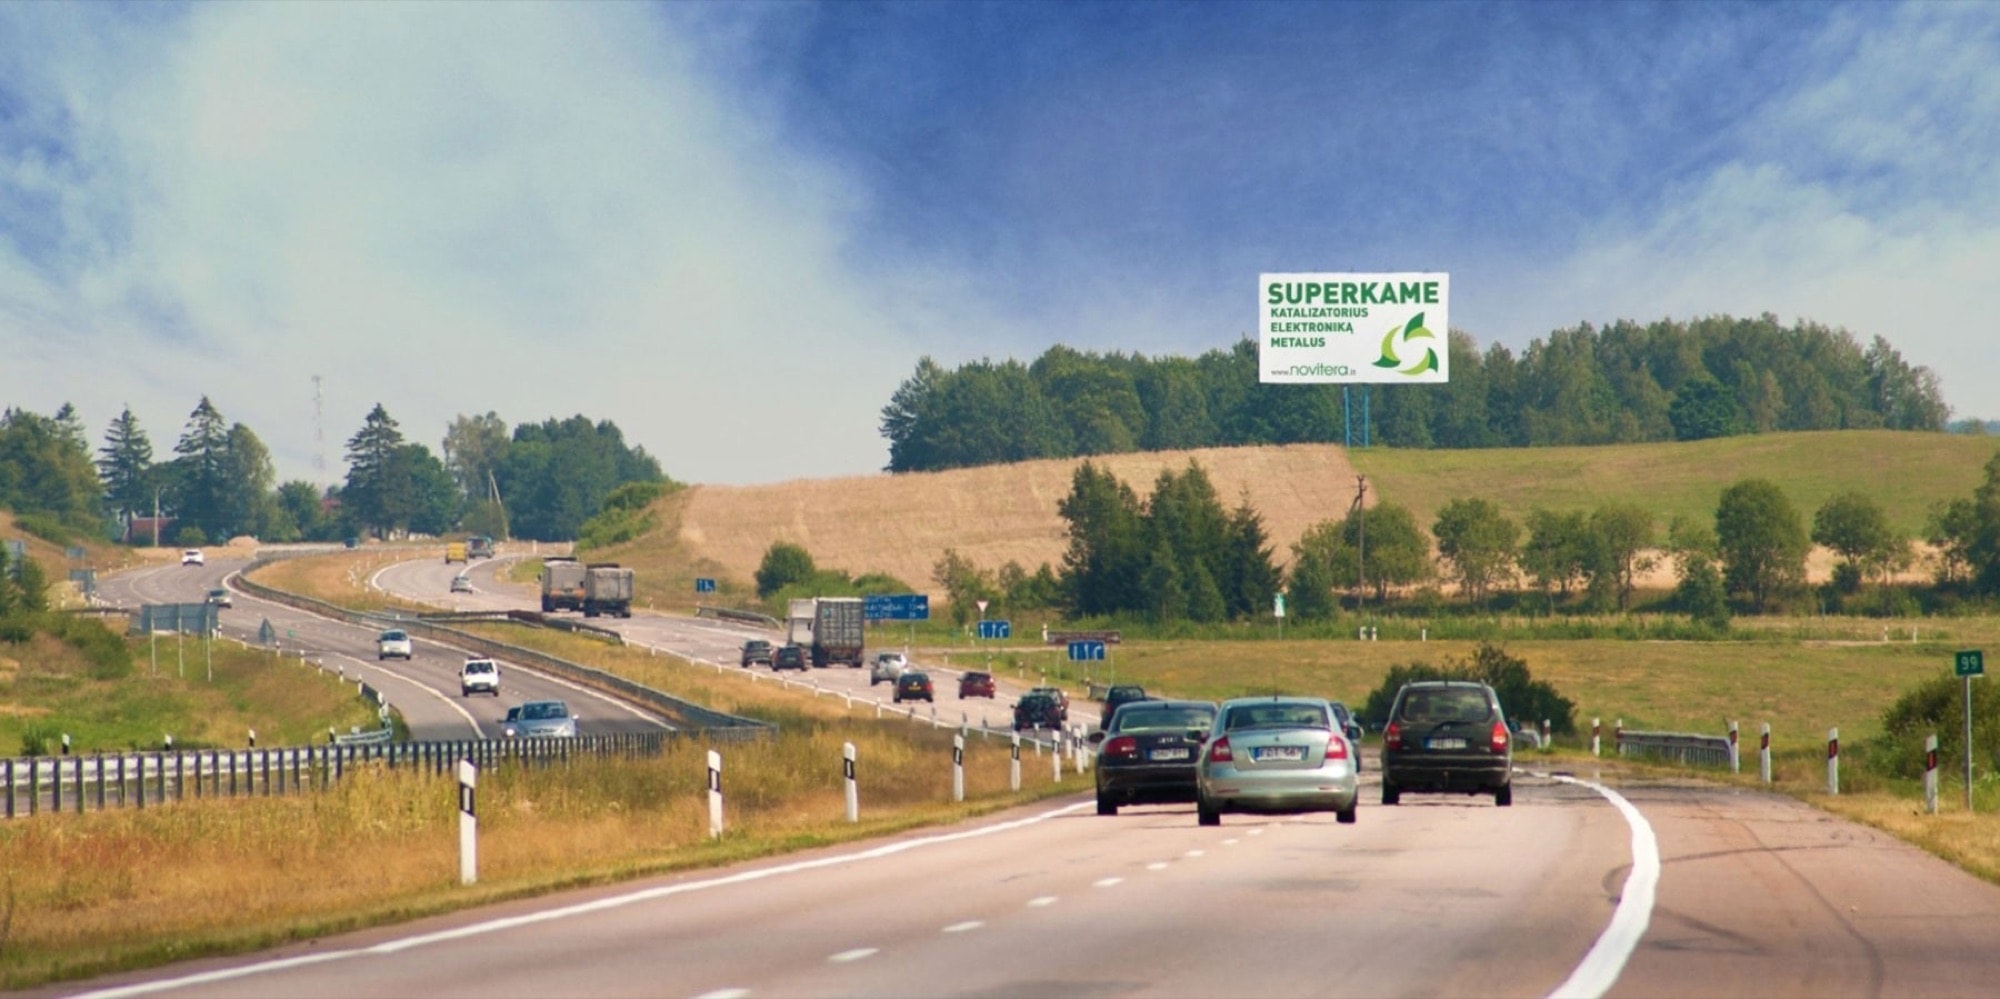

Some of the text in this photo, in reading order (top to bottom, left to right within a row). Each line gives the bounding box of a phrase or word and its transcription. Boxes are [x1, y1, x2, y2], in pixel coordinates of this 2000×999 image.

[1268, 282, 1439, 304] SUPERKAME
[1271, 308, 1368, 317] KATALIZATORIUS
[1271, 322, 1354, 334] ELEKTRONIKĄ
[1271, 337, 1326, 347] METALUS
[1961, 655, 1978, 670] 99
